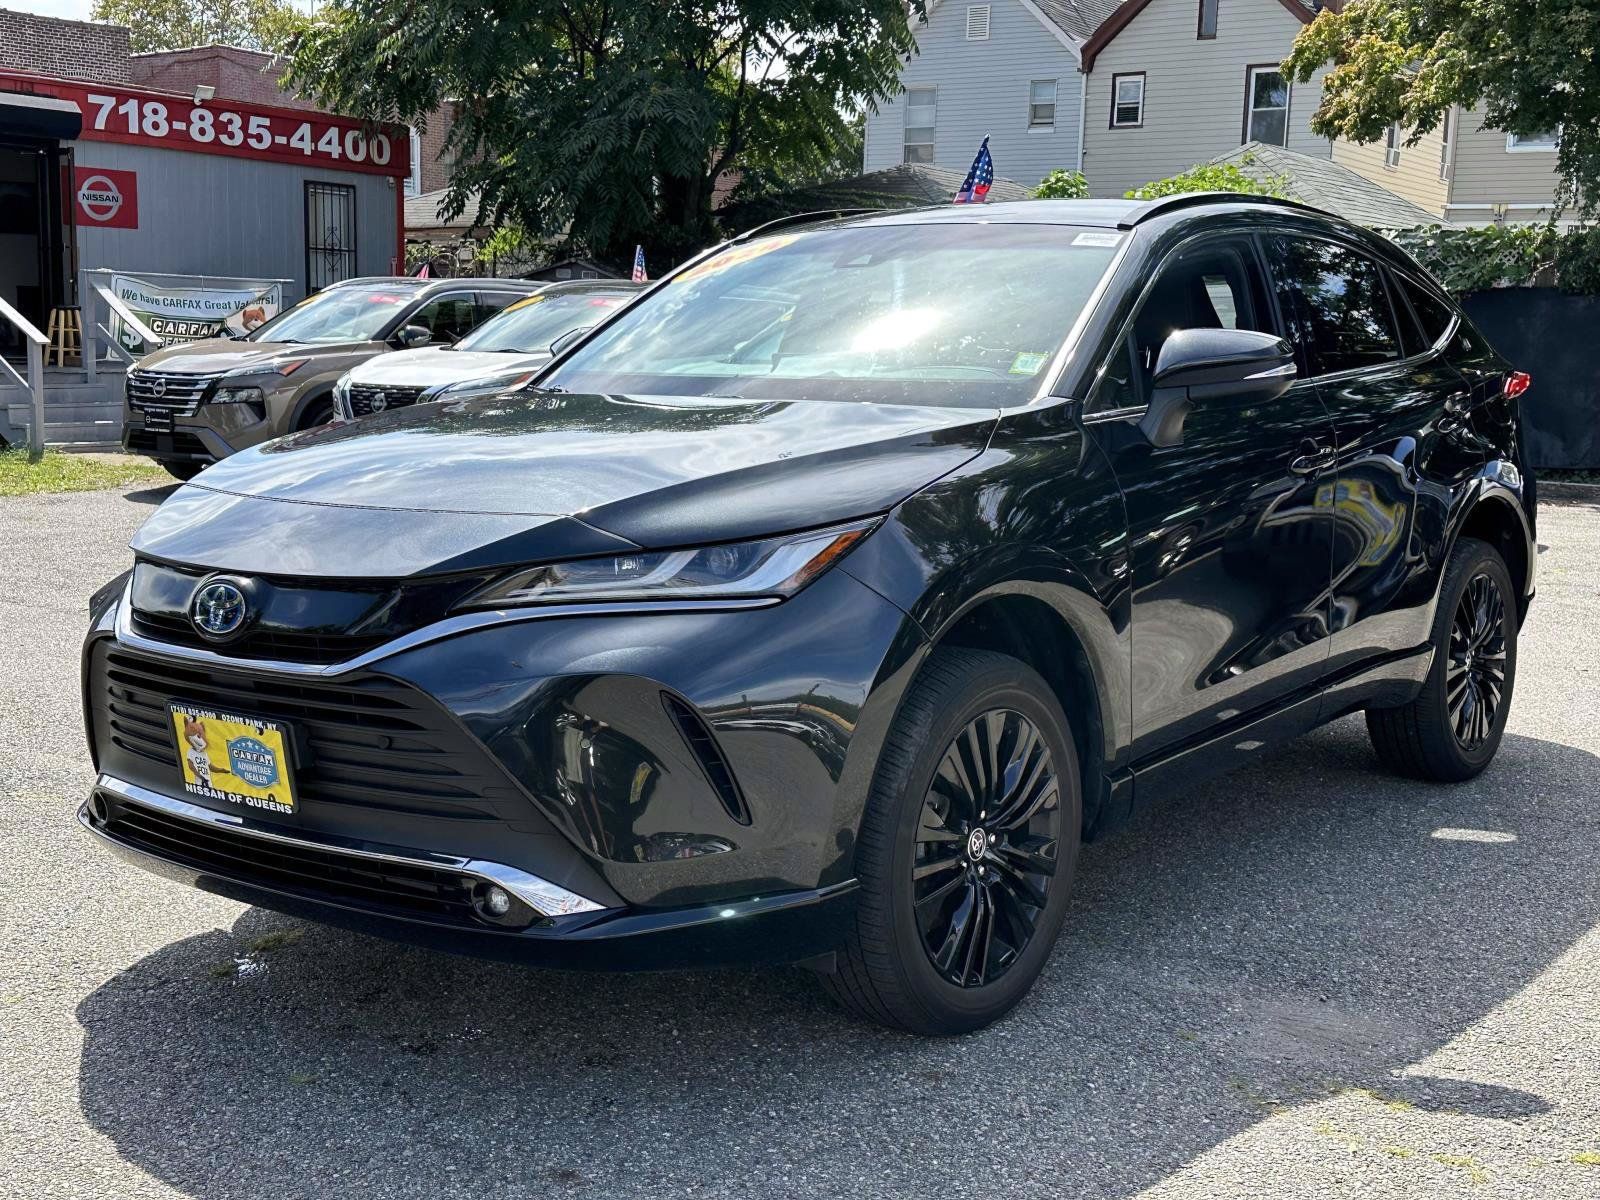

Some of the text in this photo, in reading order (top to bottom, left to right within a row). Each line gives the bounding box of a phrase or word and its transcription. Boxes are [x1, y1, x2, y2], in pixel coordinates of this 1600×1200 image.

[88, 94, 391, 166] 718-835-4400
[82, 191, 119, 203] NISSAN
[121, 288, 138, 301] We
[140, 293, 160, 306] have
[163, 299, 202, 310] CARFAX
[204, 300, 231, 310] Great
[221, 713, 245, 725] OZONE
[267, 722, 277, 731] NY
[232, 749, 273, 766] CARFAX
[237, 761, 272, 776] ADVANTAGE
[244, 772, 268, 784] DEALER
[185, 783, 293, 814] NISSAN OF QUEENS
